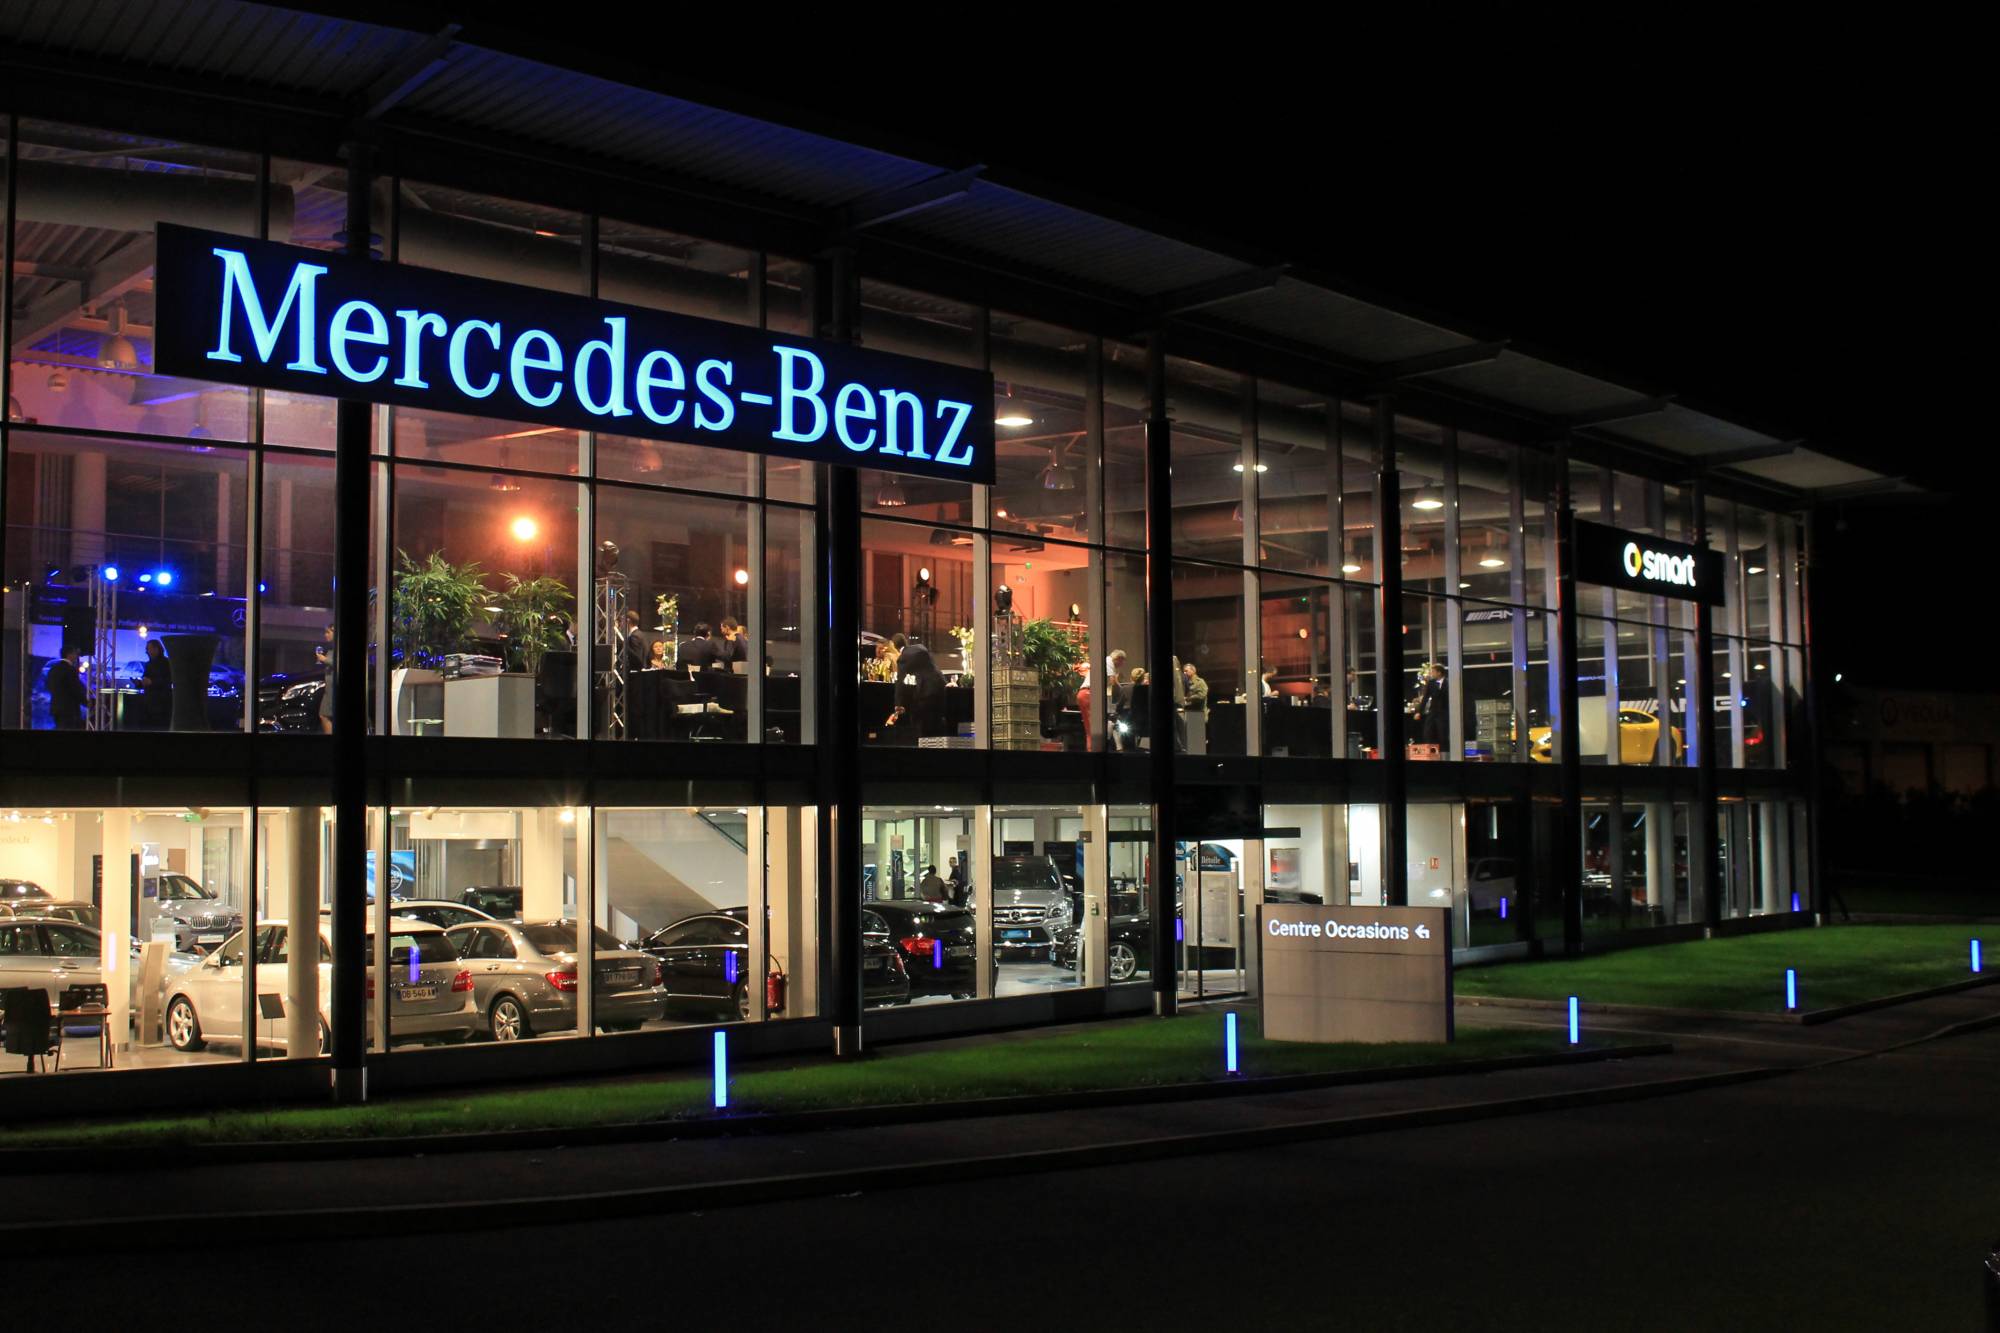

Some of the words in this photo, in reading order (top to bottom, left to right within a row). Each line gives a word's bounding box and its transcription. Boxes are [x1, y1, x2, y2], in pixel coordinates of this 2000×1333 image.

[206, 248, 974, 467] Mercedes-Benz
[1642, 549, 1696, 587] smart
[1268, 918, 1322, 938] Centre
[1324, 919, 1410, 940] Occasions
